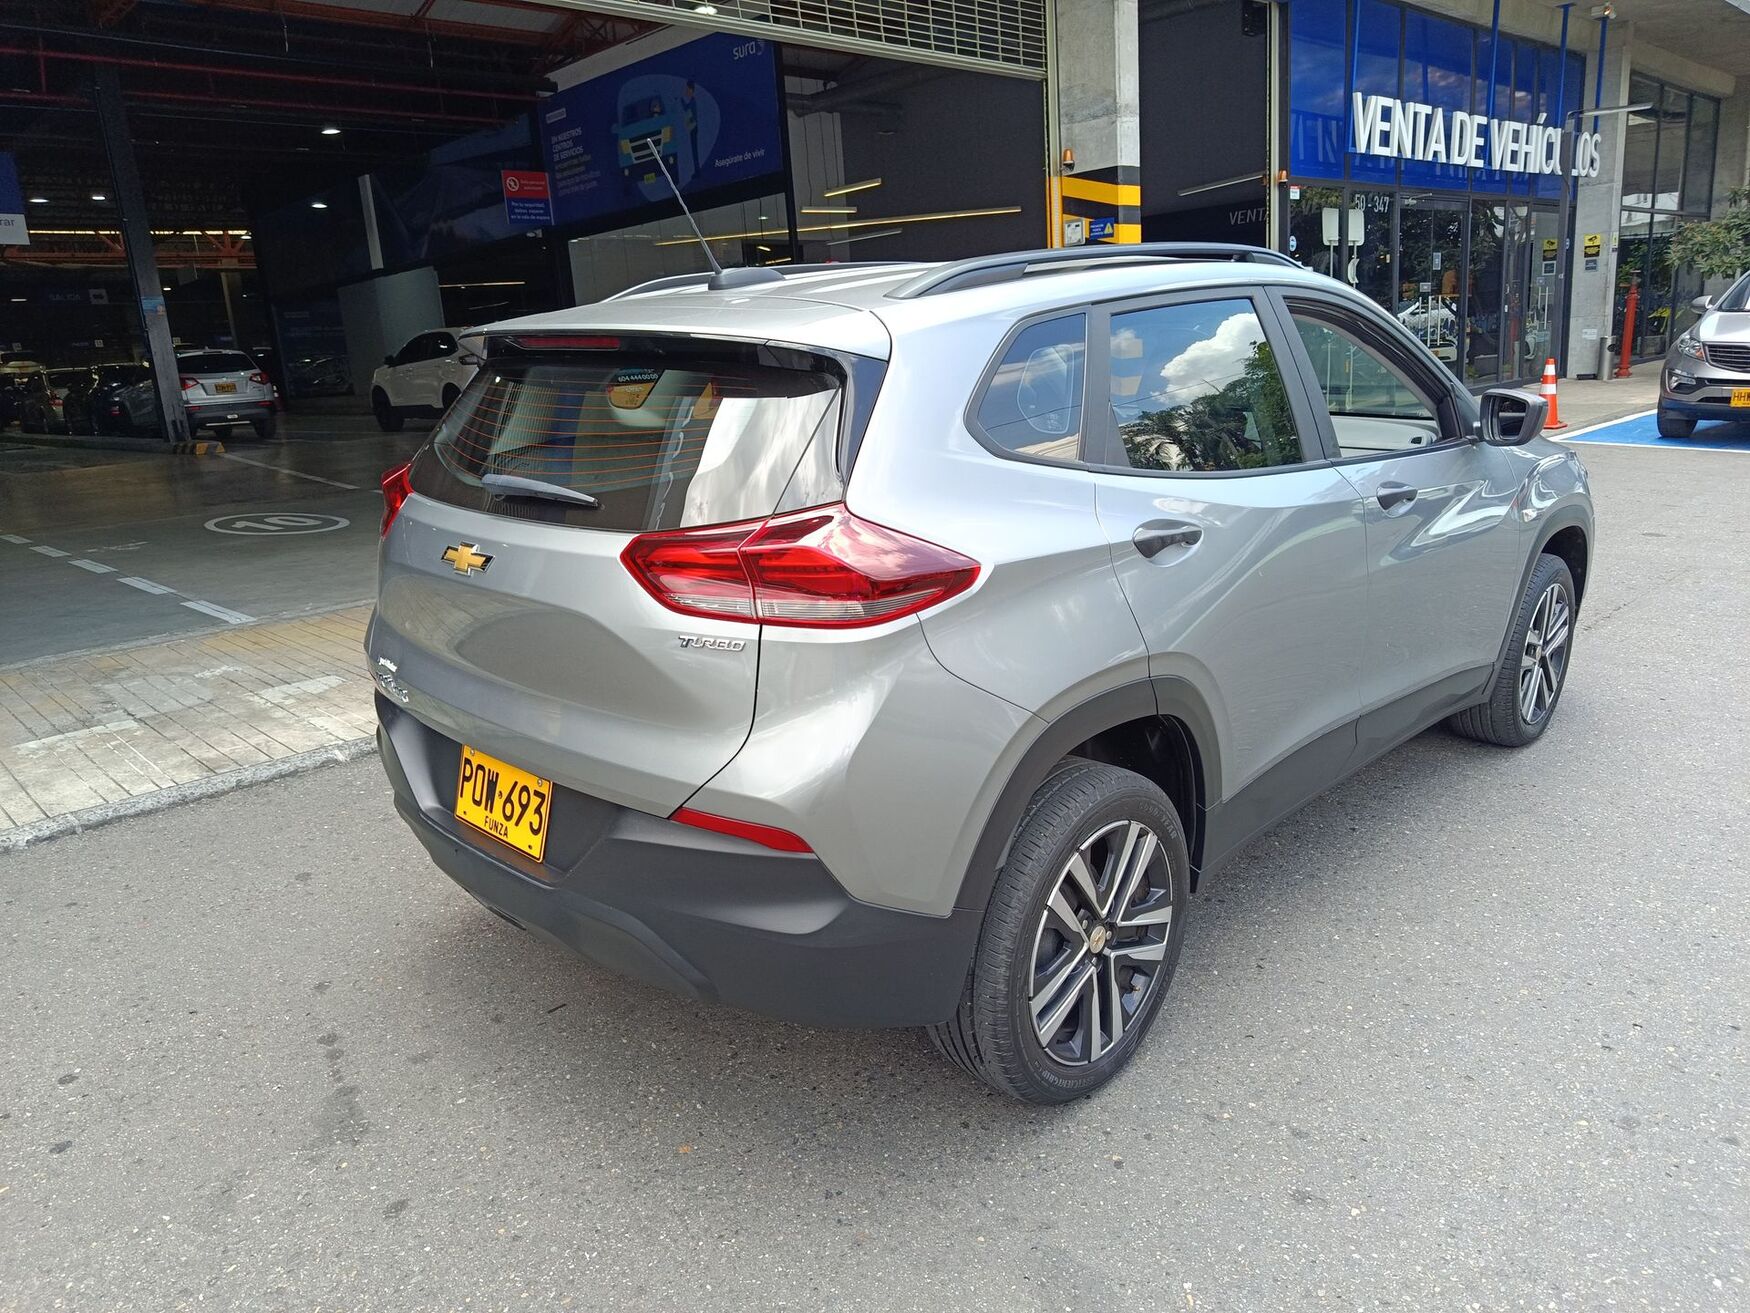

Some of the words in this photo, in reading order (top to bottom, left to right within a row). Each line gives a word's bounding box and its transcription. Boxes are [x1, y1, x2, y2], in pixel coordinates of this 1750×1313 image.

[733, 41, 756, 60] sura
[1352, 91, 1447, 163] VENTA
[1449, 110, 1488, 168] DE
[1490, 112, 1602, 178] VEHÍCUOS
[1354, 193, 1366, 212] 50
[1373, 195, 1390, 214] 347
[231, 516, 322, 531] 10
[678, 635, 746, 651] TURBO
[484, 815, 508, 839] FUNZA
